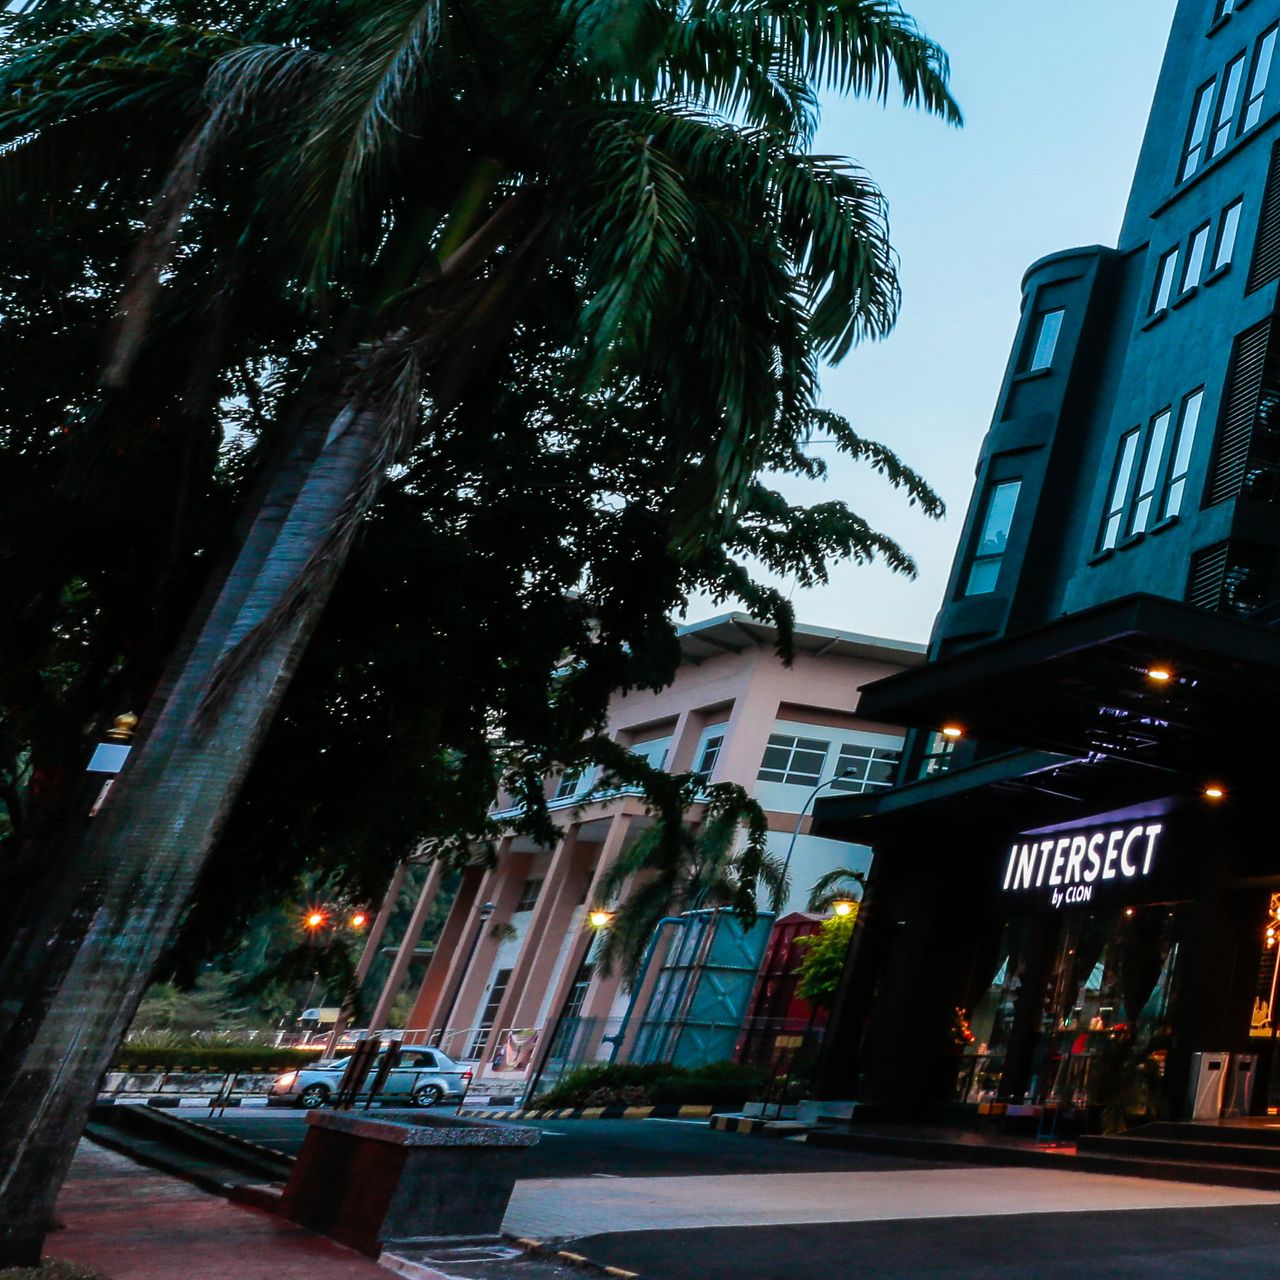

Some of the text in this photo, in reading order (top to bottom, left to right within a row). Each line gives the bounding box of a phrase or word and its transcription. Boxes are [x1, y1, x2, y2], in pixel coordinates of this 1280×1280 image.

[1002, 824, 1162, 890] INTERSECT
[1051, 886, 1093, 909] by CLON
